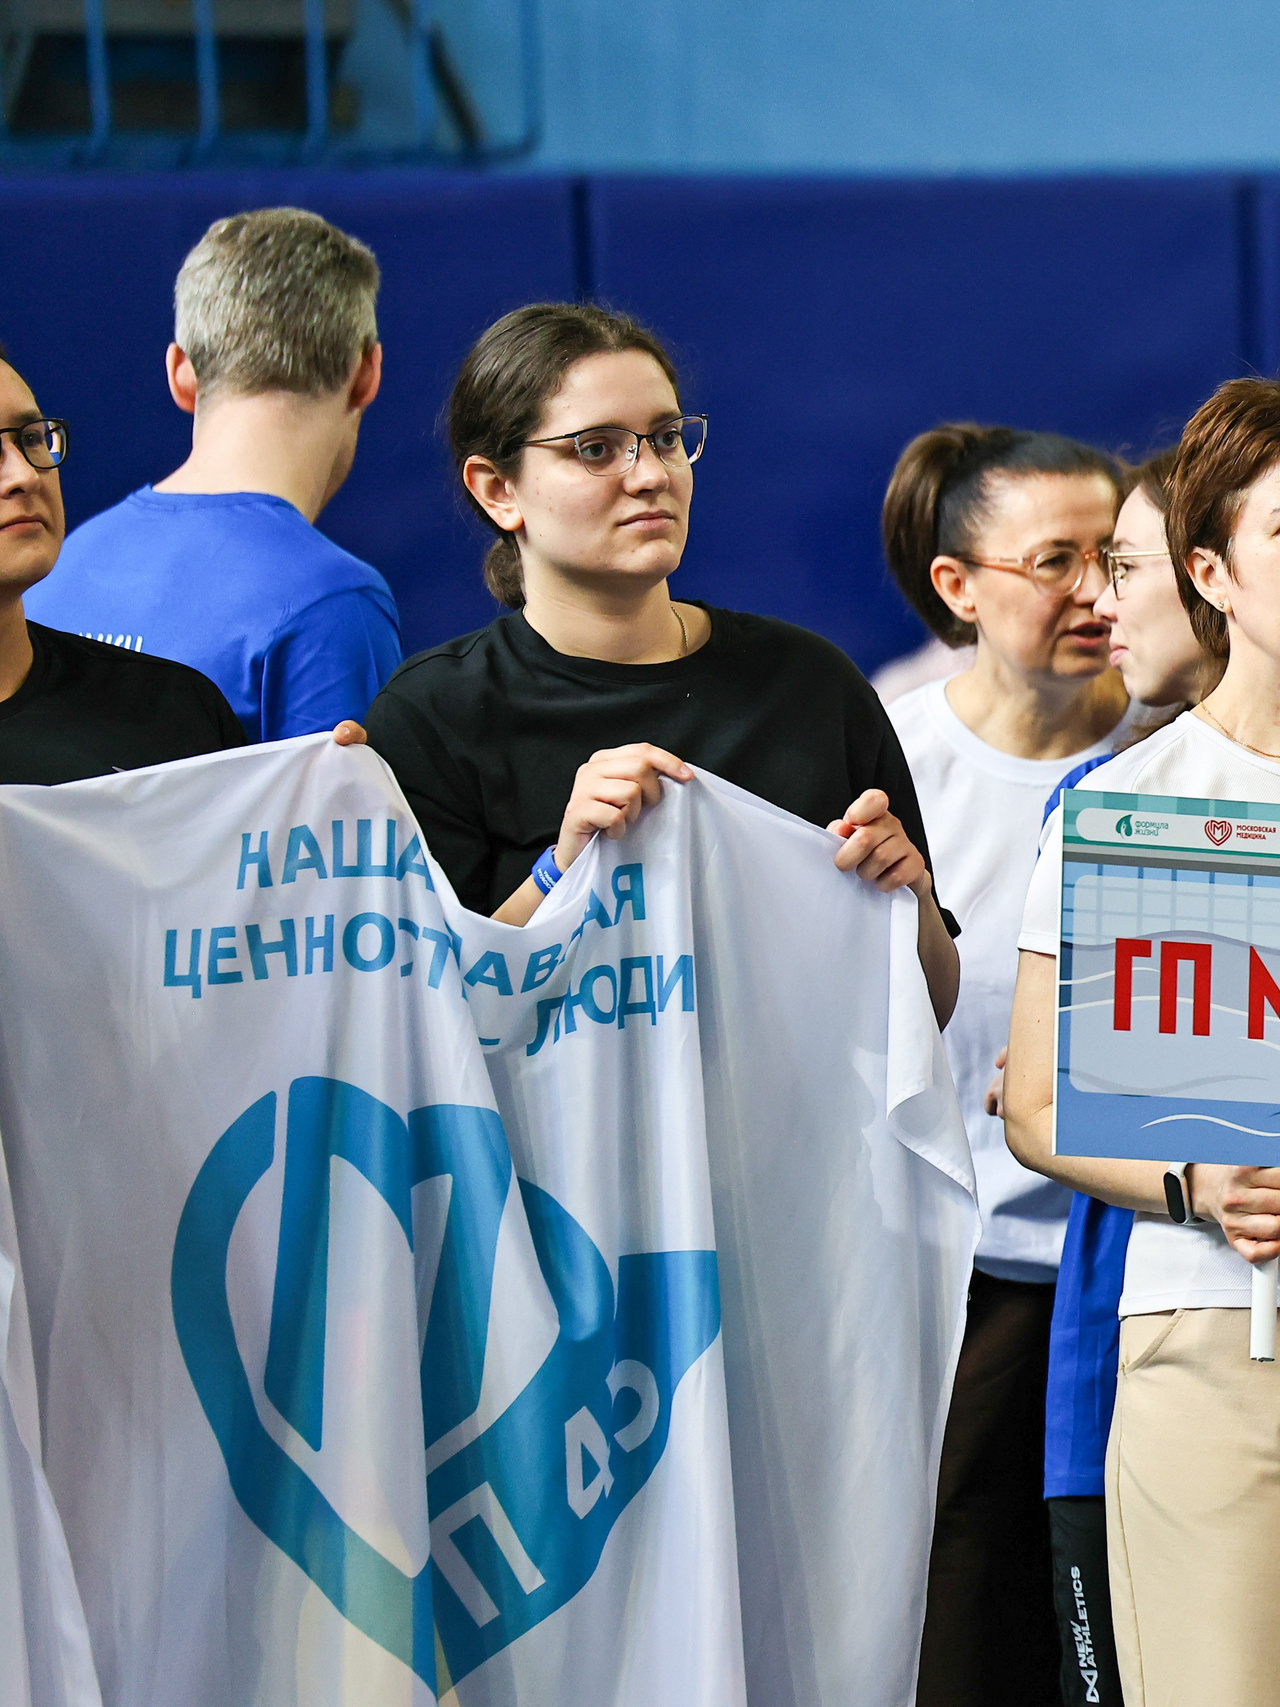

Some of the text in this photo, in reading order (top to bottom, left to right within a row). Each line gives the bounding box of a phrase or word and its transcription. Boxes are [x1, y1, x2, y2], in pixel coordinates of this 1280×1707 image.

[236, 818, 436, 893] НАША
[1236, 824, 1277, 833] МОСКОВСКАЯ
[1236, 832, 1267, 840] МЕДИЦИНА
[526, 954, 695, 1057] ЛЮДИ
[1114, 938, 1212, 1036] ГП
[1069, 1620, 1088, 1668] NEW
[1070, 1565, 1097, 1668] ATHLETICS
